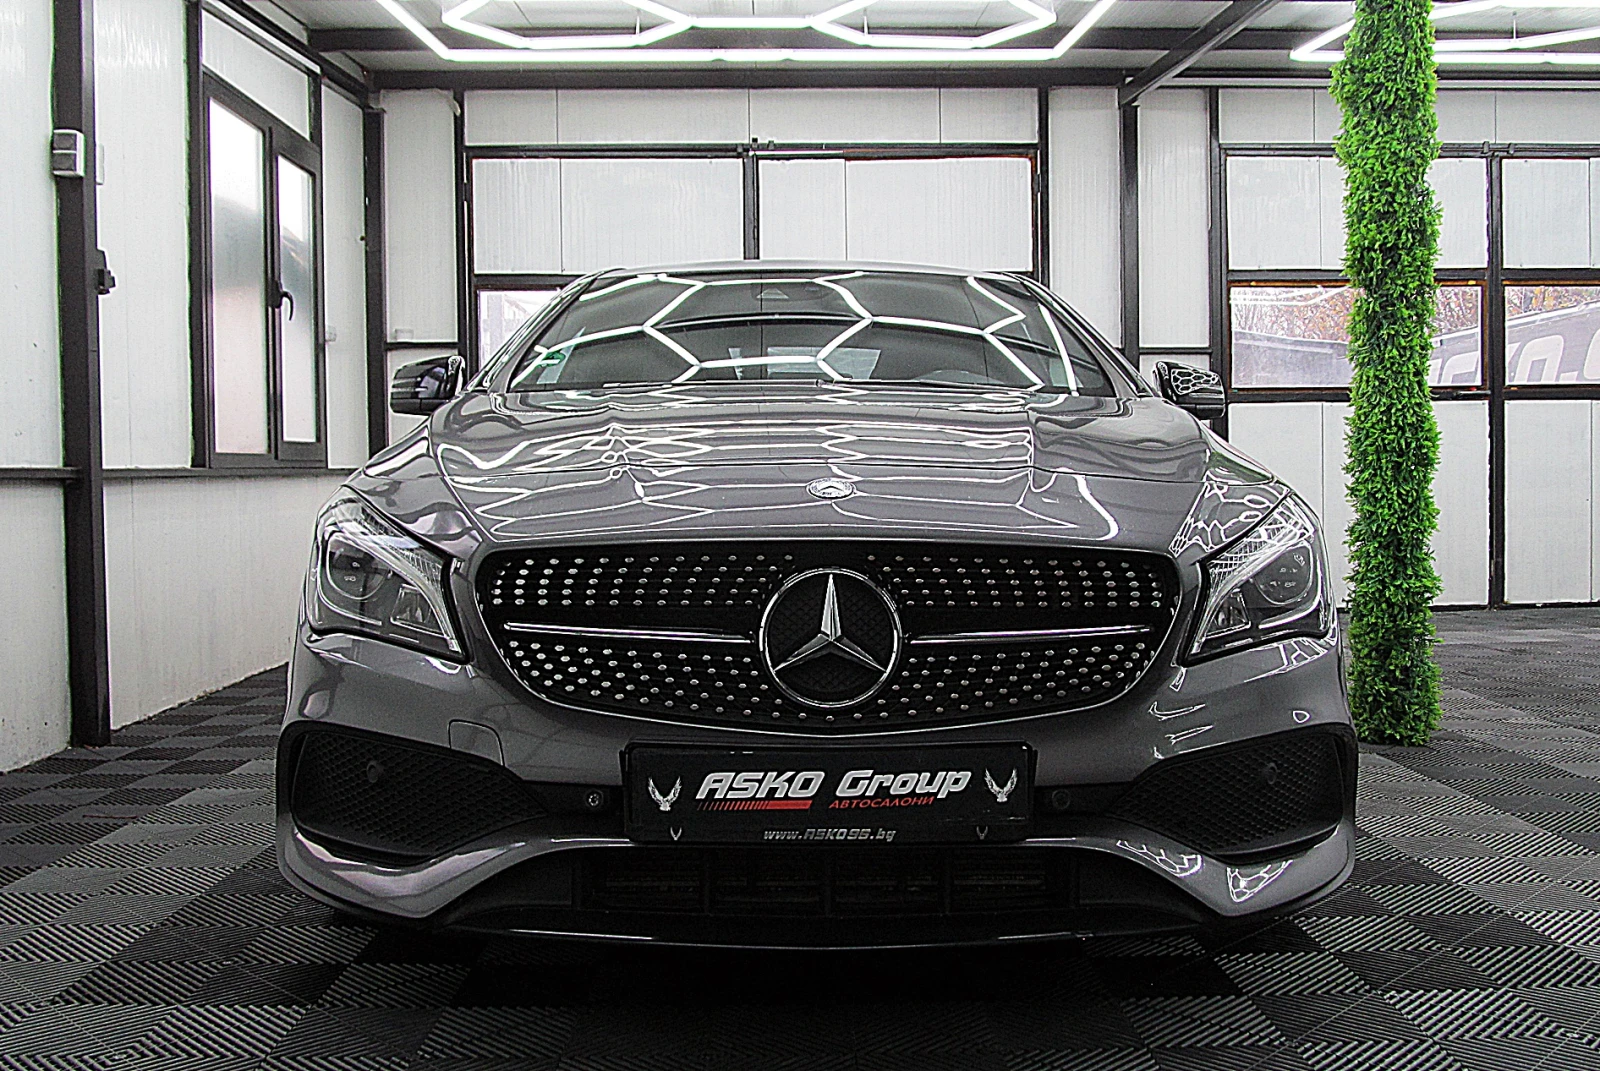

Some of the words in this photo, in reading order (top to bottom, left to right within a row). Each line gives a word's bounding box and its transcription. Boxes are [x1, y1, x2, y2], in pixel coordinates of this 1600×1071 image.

[695, 771, 825, 799] ASKO
[834, 769, 972, 798] Group
[828, 796, 935, 809] АВТОСАЛОНИ
